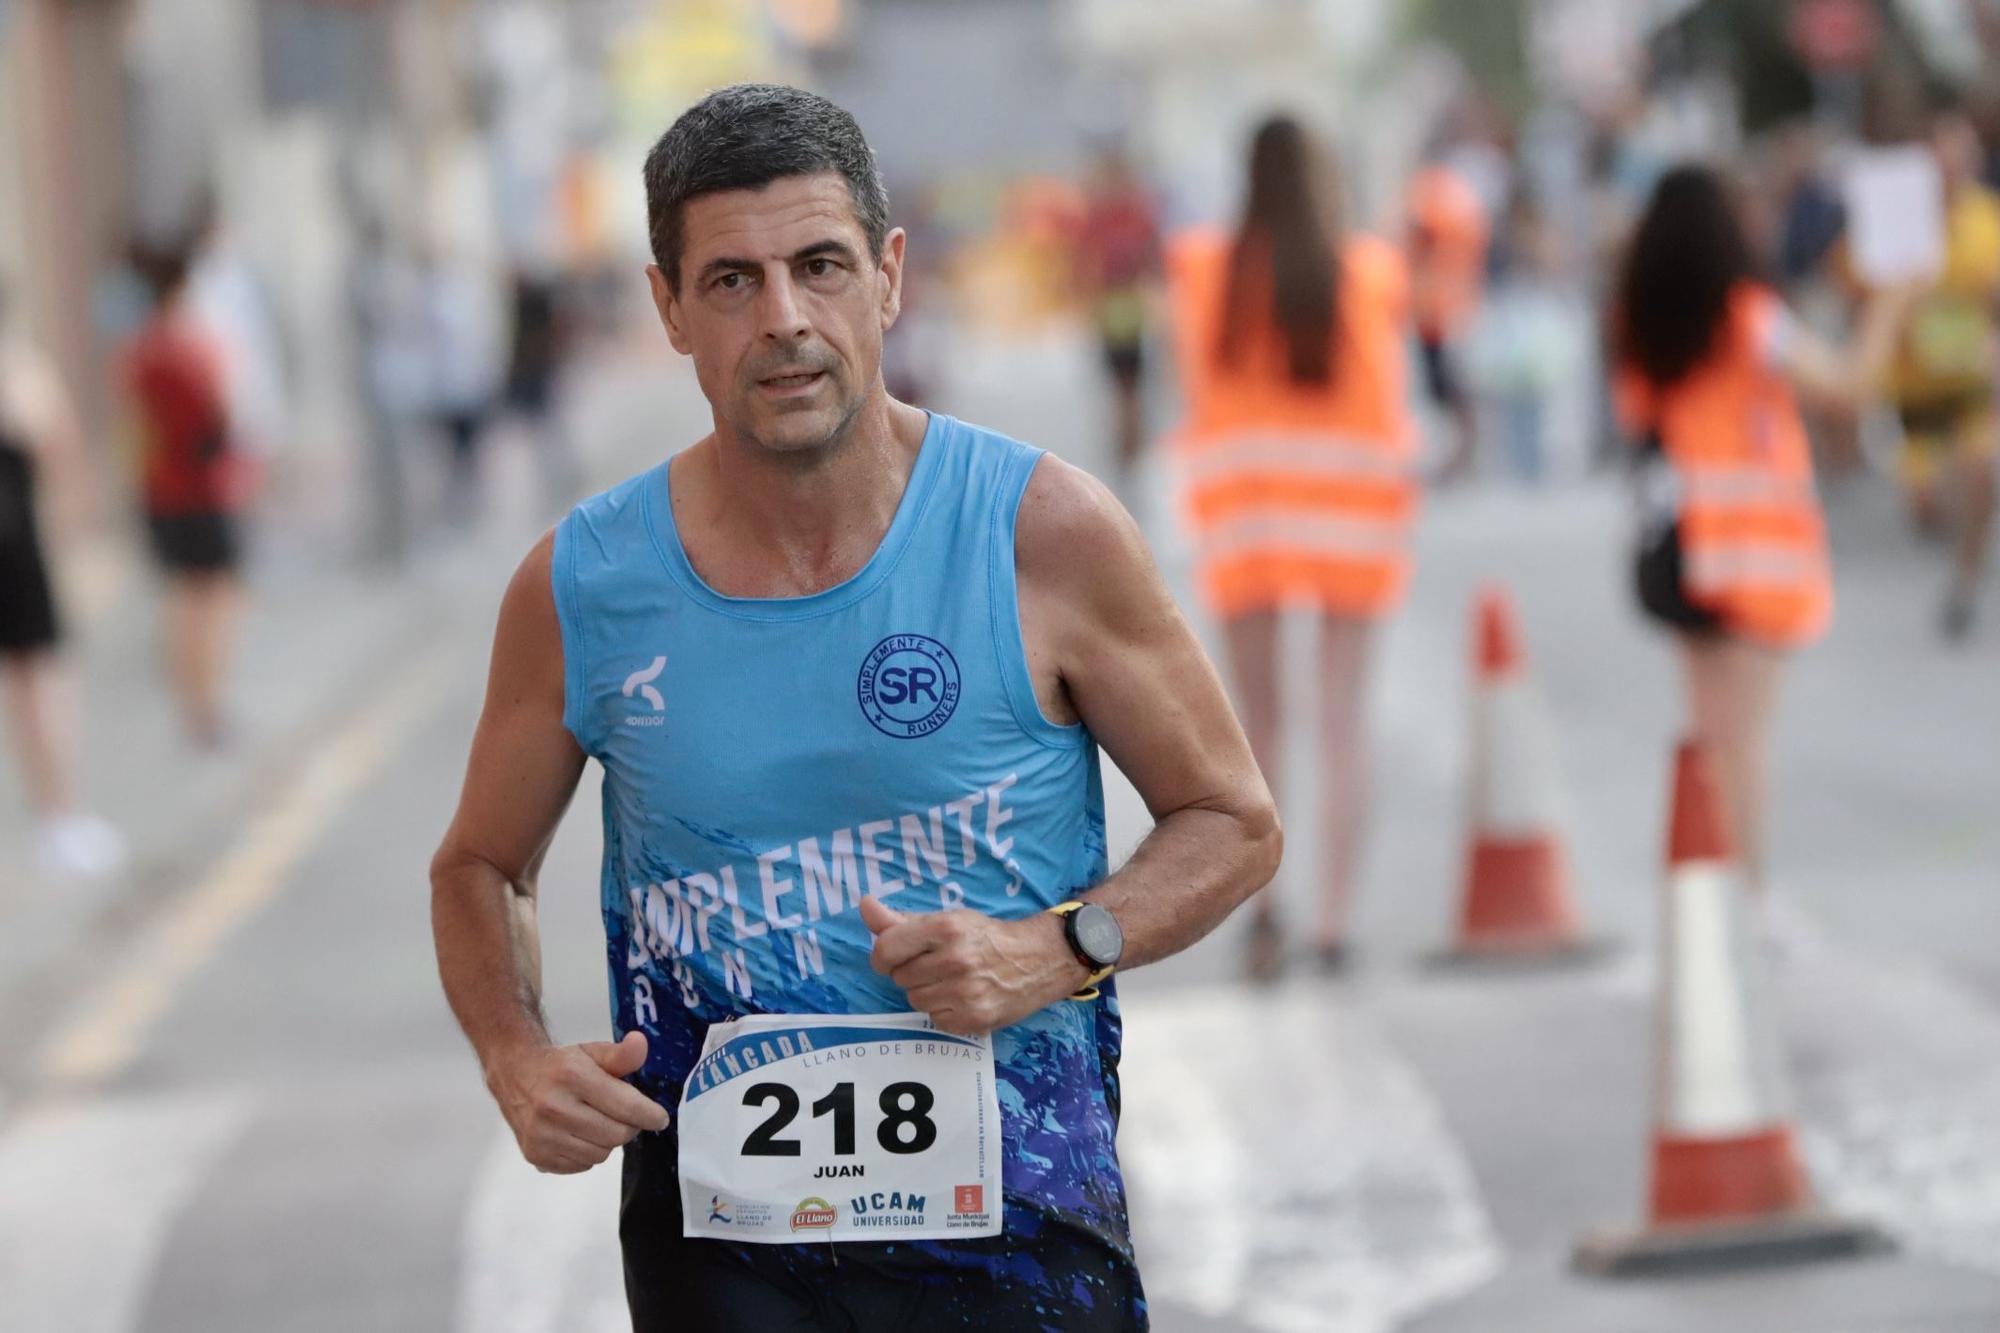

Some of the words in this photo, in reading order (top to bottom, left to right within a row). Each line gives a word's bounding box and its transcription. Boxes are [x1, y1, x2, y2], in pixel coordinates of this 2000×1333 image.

[862, 637, 926, 705] SIMPLEMENTE
[879, 667, 938, 705] SR
[907, 682, 958, 735] RUNNERS
[696, 1030, 814, 1092] ZANCADA
[803, 1046, 866, 1068] LLANO
[879, 1043, 902, 1056] DE
[915, 1043, 983, 1062] BRUJAS
[741, 1081, 937, 1157] 218
[813, 1165, 865, 1179] JUAN
[796, 1214, 805, 1224] El
[807, 1213, 833, 1223] Llano
[850, 1191, 927, 1215] UCAM
[853, 1215, 925, 1227] UNIVERSIDAD
